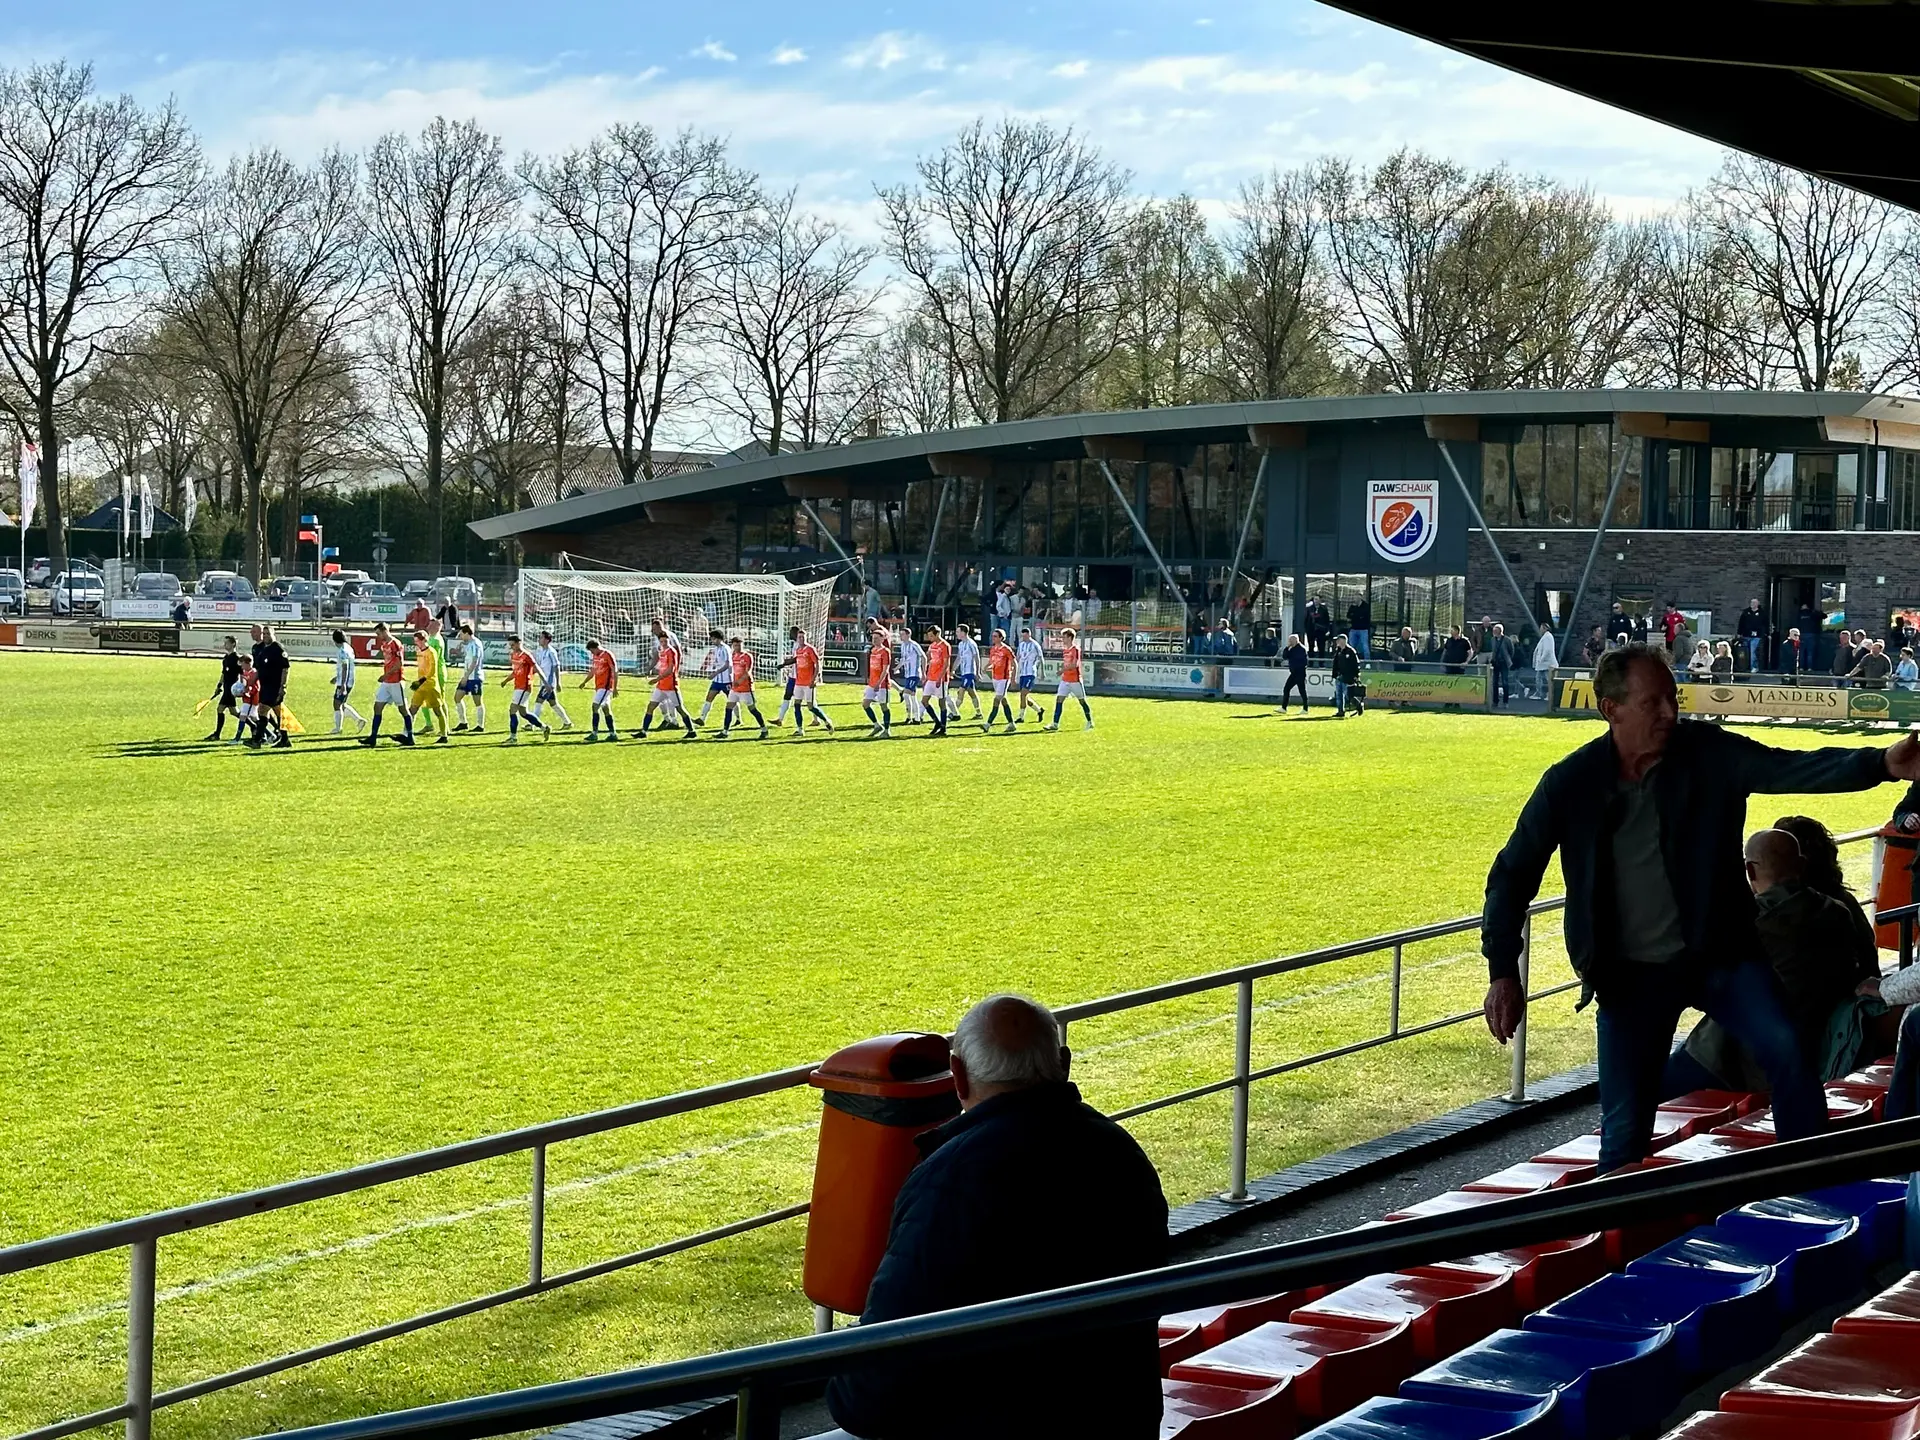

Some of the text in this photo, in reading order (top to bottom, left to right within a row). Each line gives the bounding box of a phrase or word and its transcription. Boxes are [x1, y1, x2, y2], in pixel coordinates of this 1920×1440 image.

[280, 638, 311, 647] MEGENS
[1137, 665, 1188, 675] NOTARIS
[1379, 677, 1460, 690] Tuinbouwbedrijf
[1746, 689, 1837, 707] MANDERS
